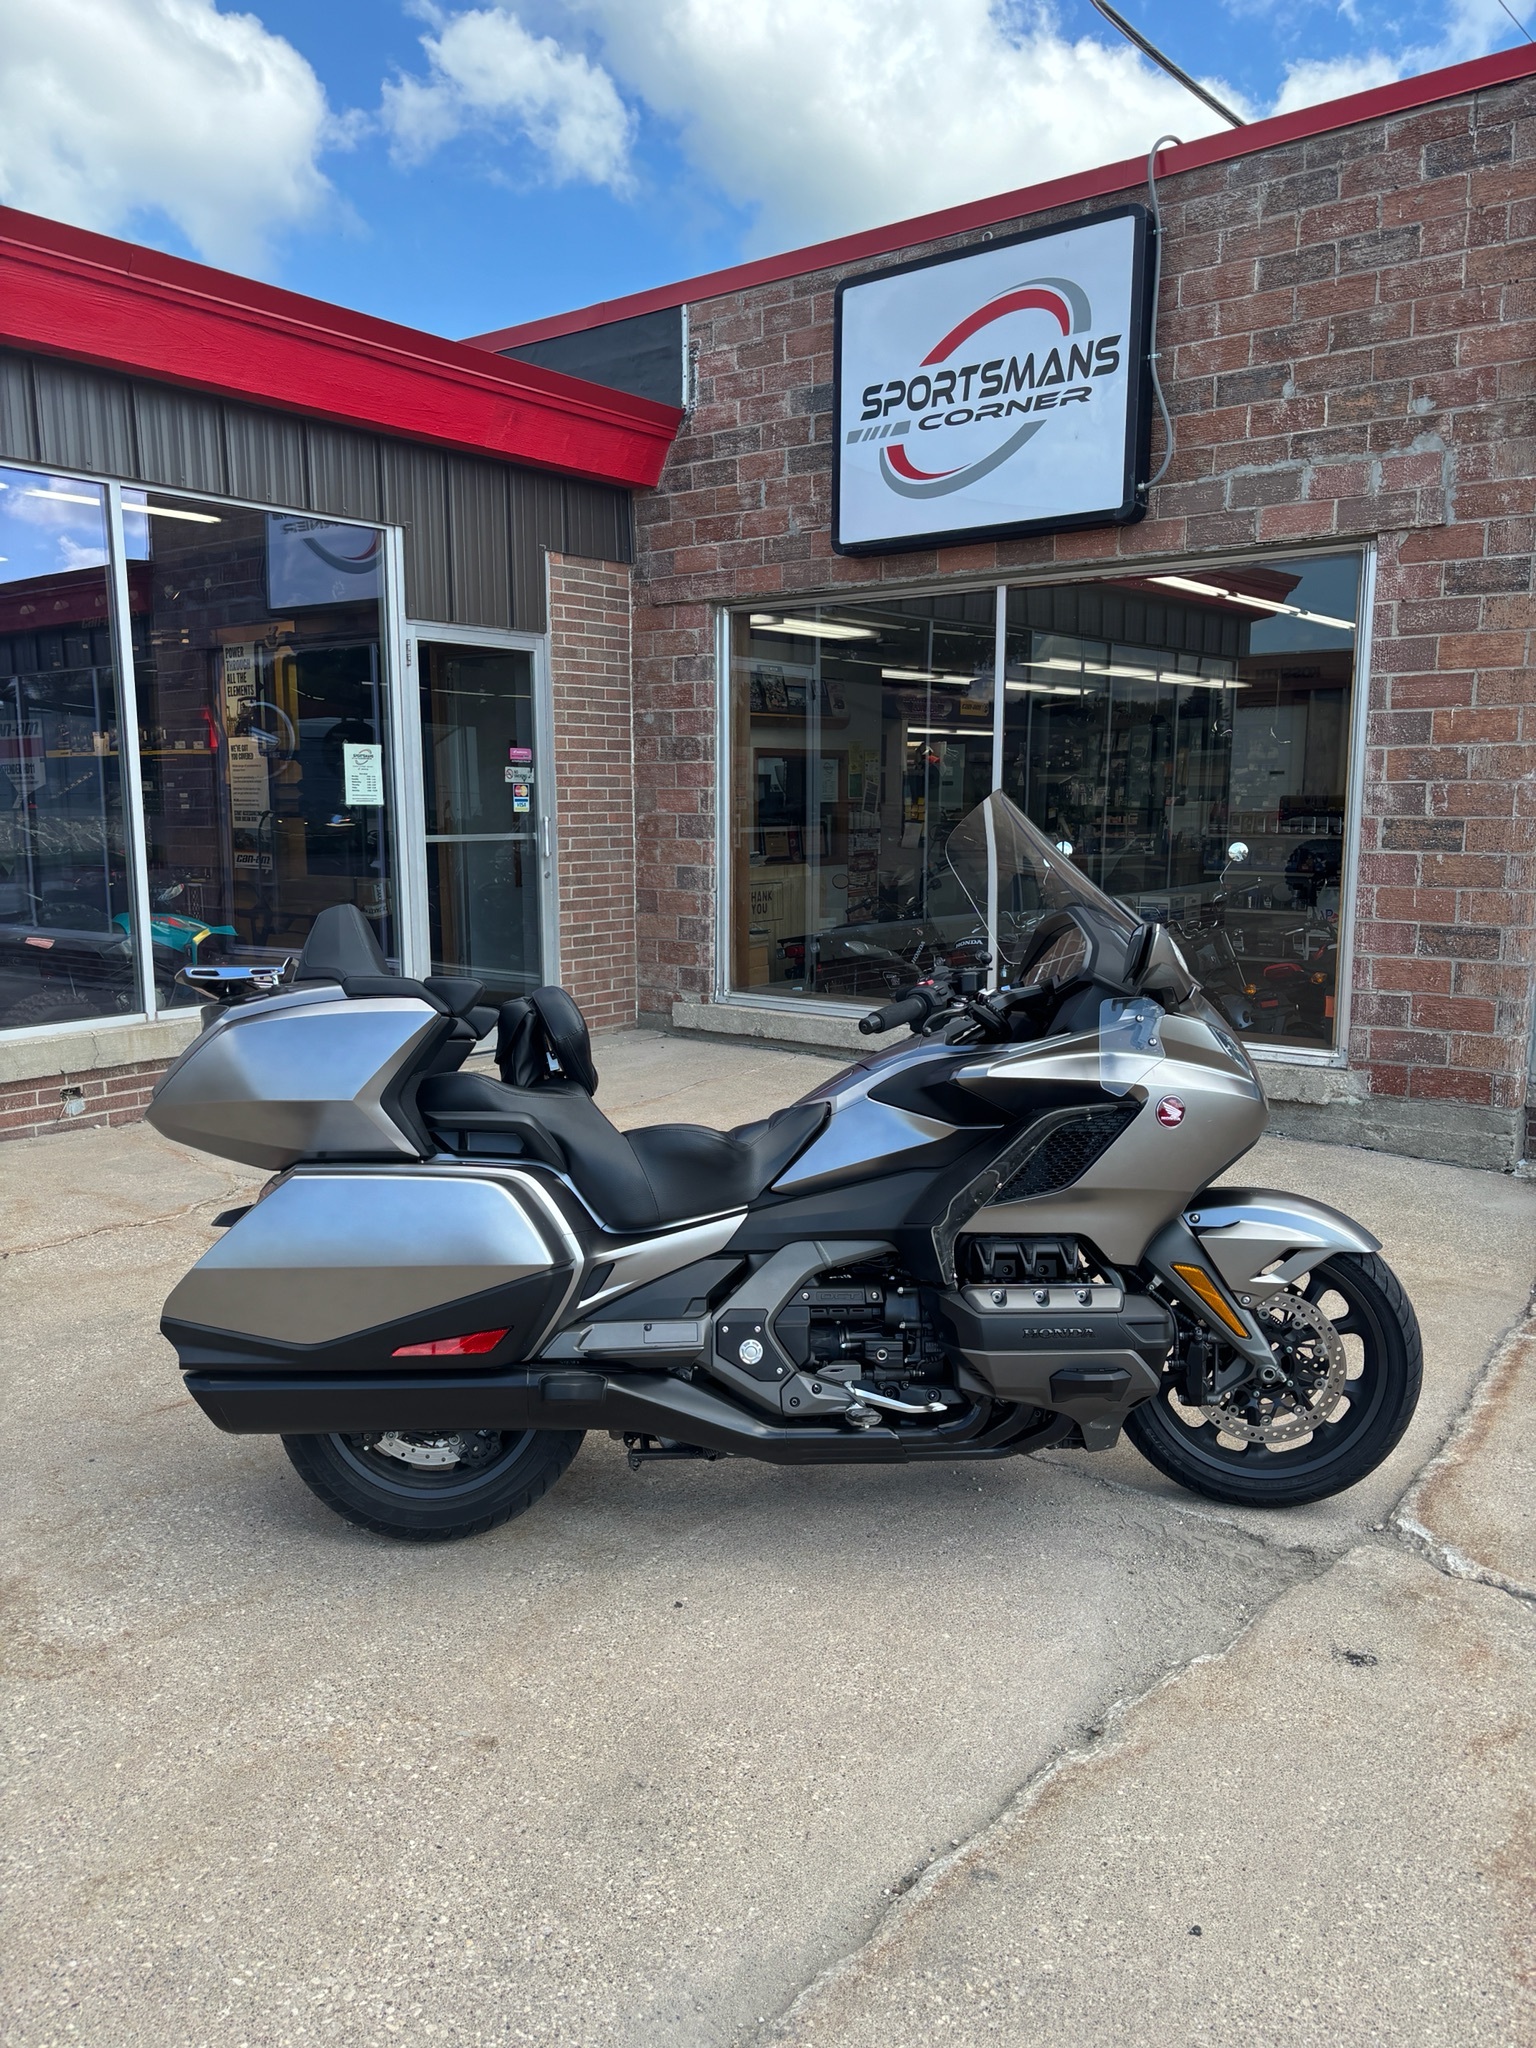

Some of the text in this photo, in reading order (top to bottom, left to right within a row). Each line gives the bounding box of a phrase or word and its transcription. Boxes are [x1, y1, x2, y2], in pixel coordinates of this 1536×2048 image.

[860, 334, 1122, 422] SPORTSMANS
[918, 386, 1092, 431] CORNER
[225, 646, 244, 659] POWER
[227, 672, 247, 684] ALL THE
[227, 684, 255, 697] ELEMENTS
[750, 890, 773, 903] HANK
[751, 903, 768, 915] YOU
[956, 938, 984, 949] HONDA
[911, 941, 926, 964] HONDA
[1022, 1327, 1096, 1339] HONDA
